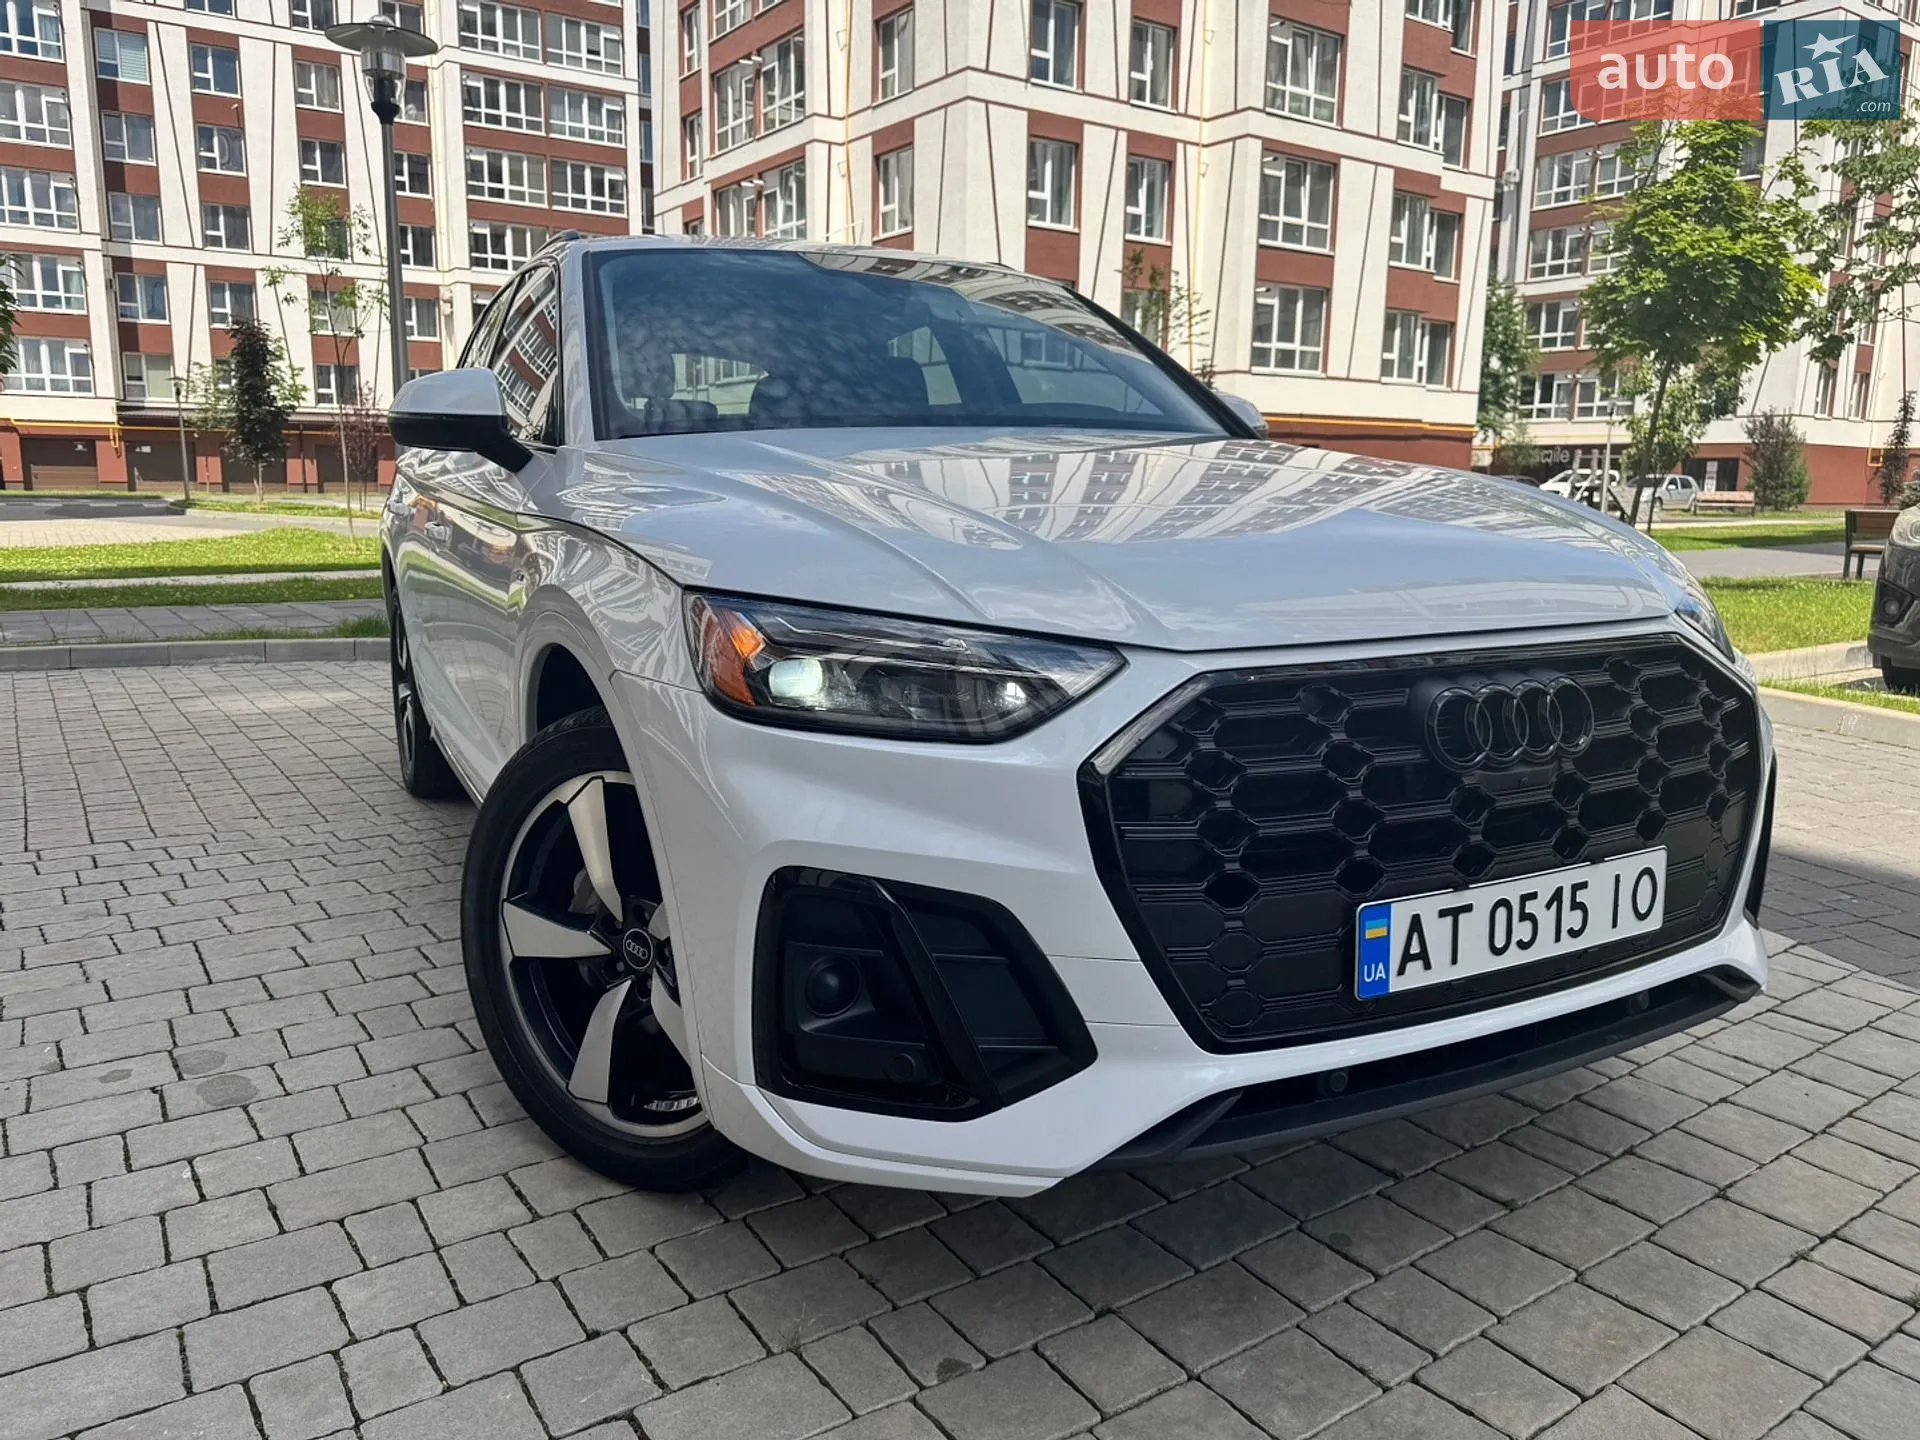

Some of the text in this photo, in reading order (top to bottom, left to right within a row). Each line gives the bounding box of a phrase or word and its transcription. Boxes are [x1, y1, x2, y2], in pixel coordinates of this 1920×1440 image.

[1396, 867, 1658, 976] AT 0515 IO
[1363, 964, 1386, 982] UA
